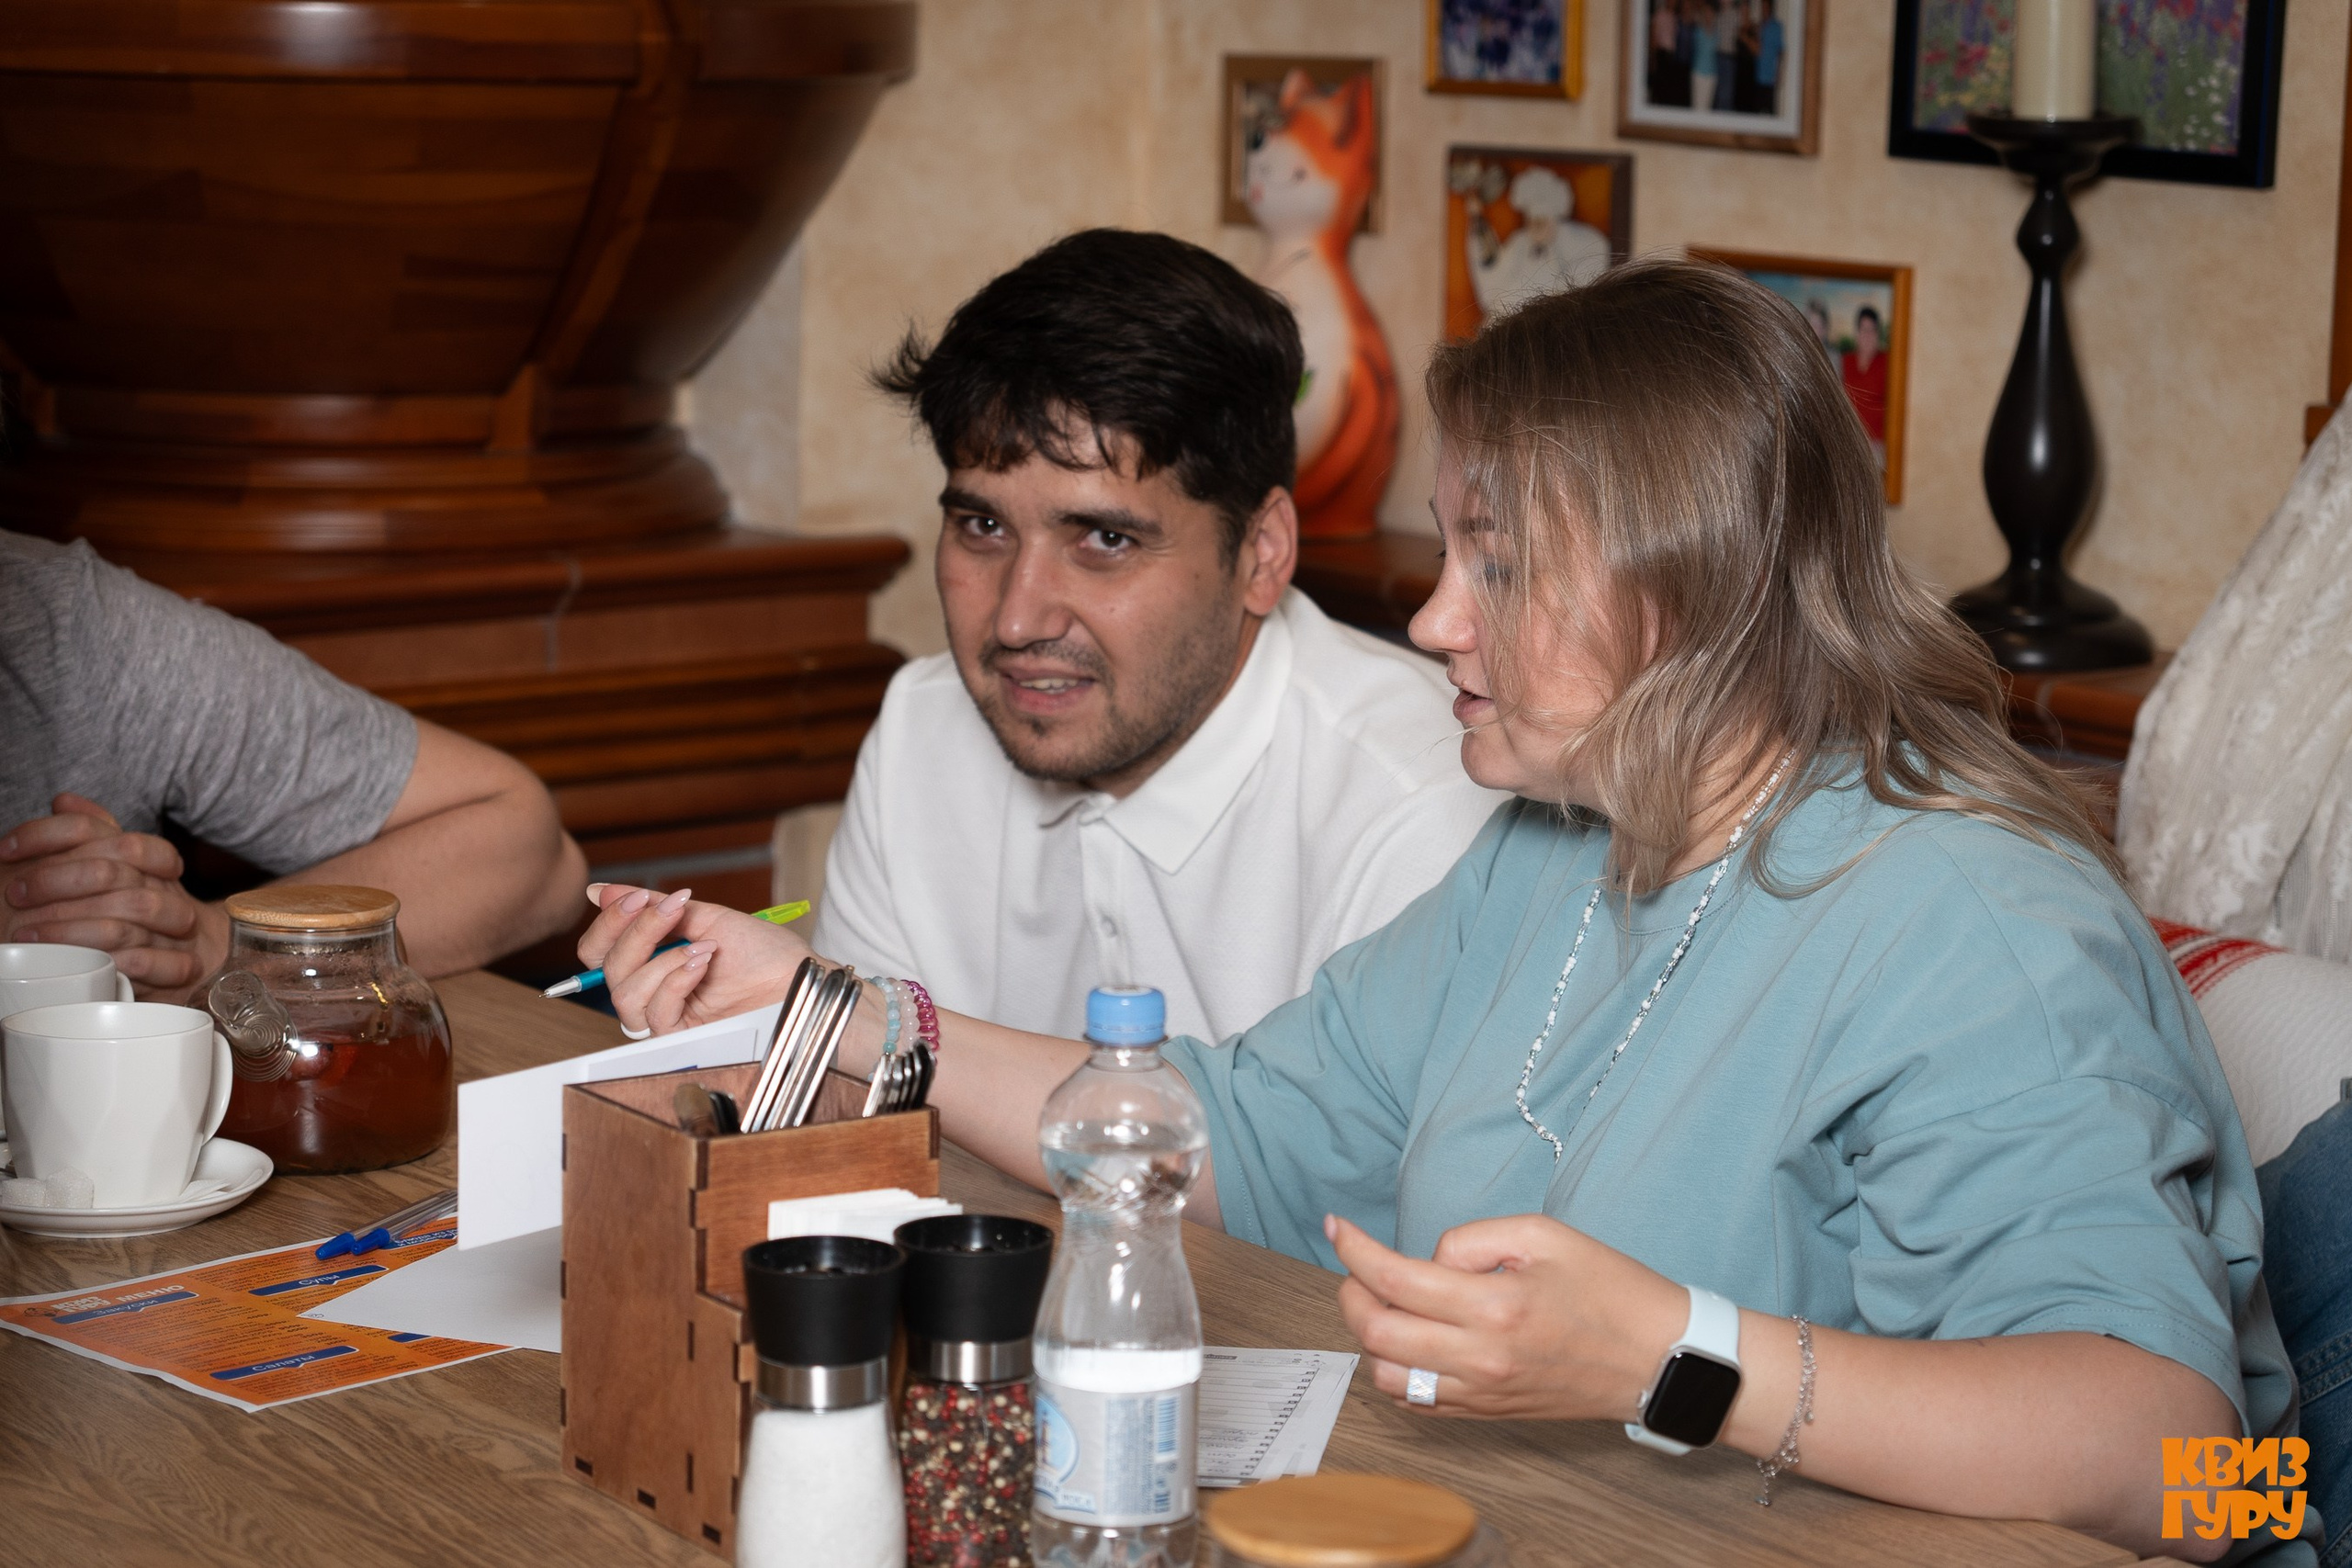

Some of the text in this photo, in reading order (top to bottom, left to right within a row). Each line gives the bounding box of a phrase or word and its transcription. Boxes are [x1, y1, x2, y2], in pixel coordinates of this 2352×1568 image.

[299, 1274, 340, 1286] Супы
[116, 1285, 186, 1303] МЕНЮ
[93, 1299, 159, 1315] Закуски
[252, 1355, 315, 1371] Салаты
